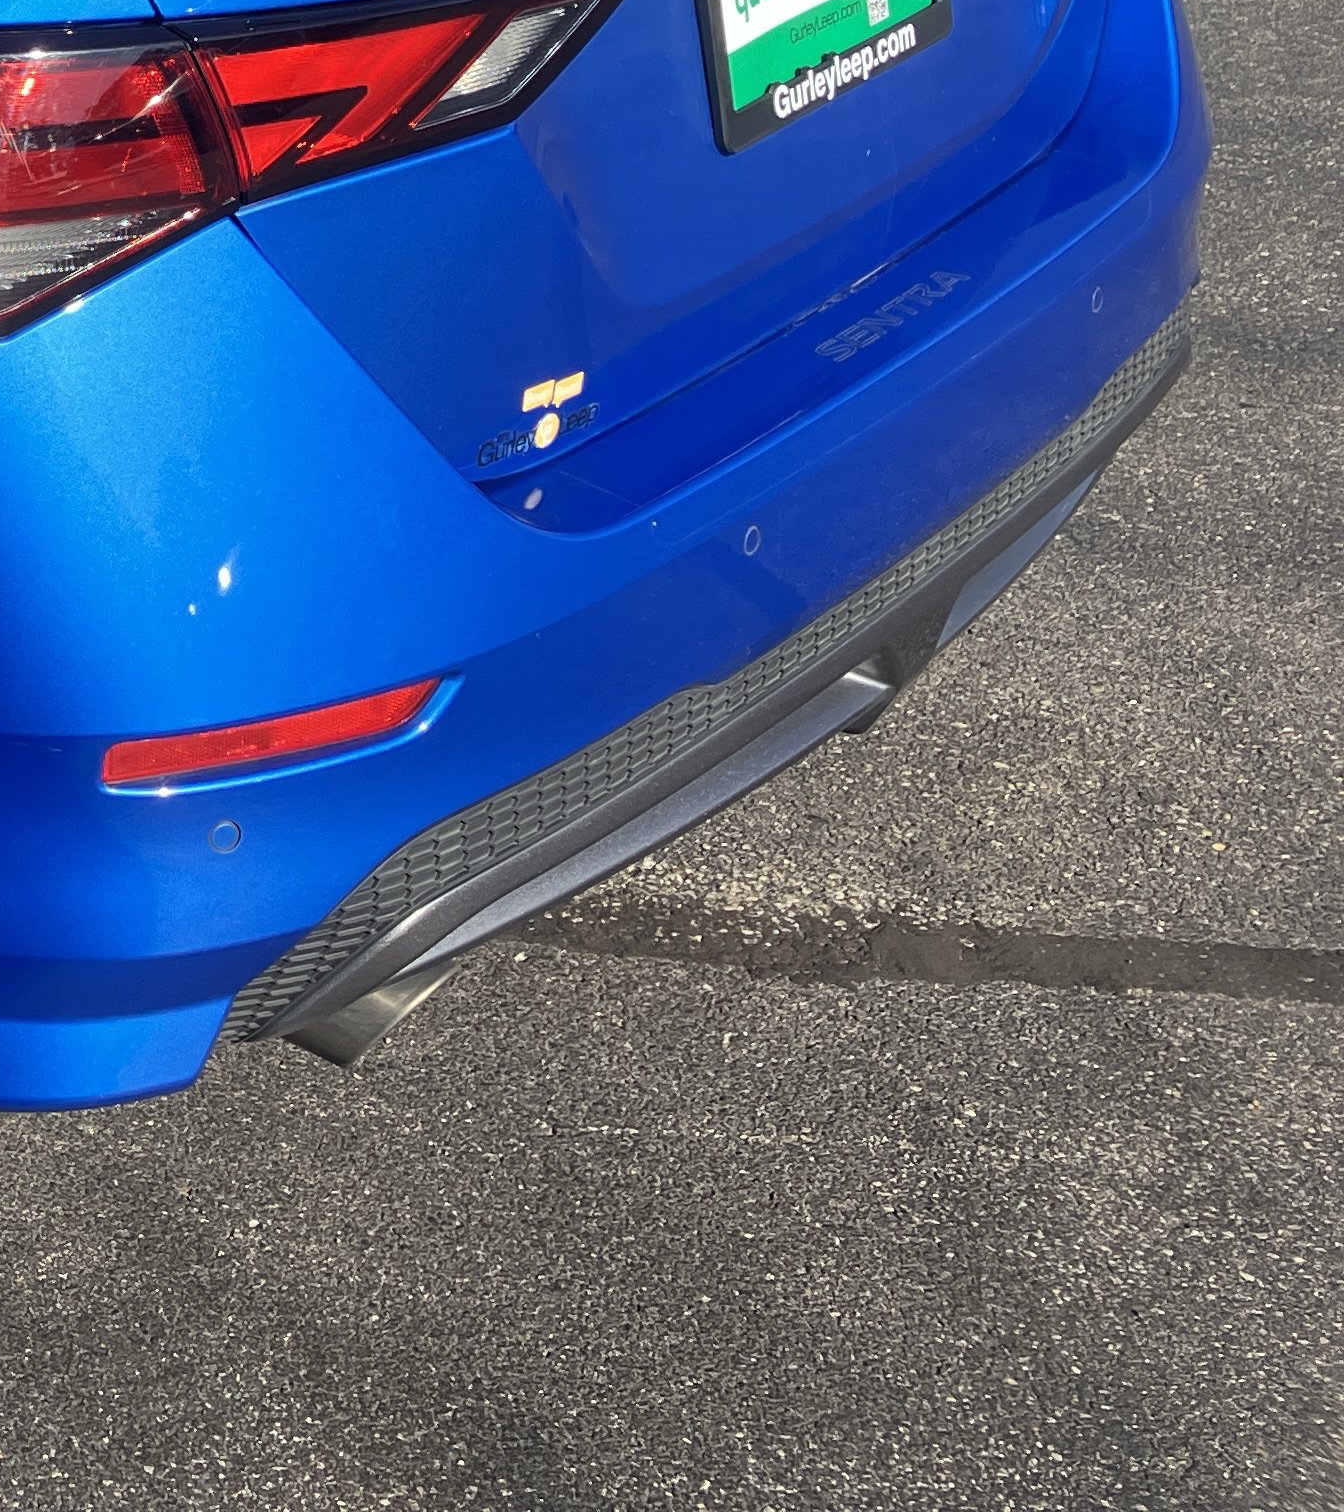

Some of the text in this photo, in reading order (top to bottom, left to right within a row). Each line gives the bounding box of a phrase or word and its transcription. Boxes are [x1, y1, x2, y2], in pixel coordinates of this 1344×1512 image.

[789, 0, 862, 44] GurleyLeep.com
[773, 23, 916, 119] Gurleyleep.com
[814, 271, 972, 363] SENTRA
[477, 430, 537, 468] Gurley
